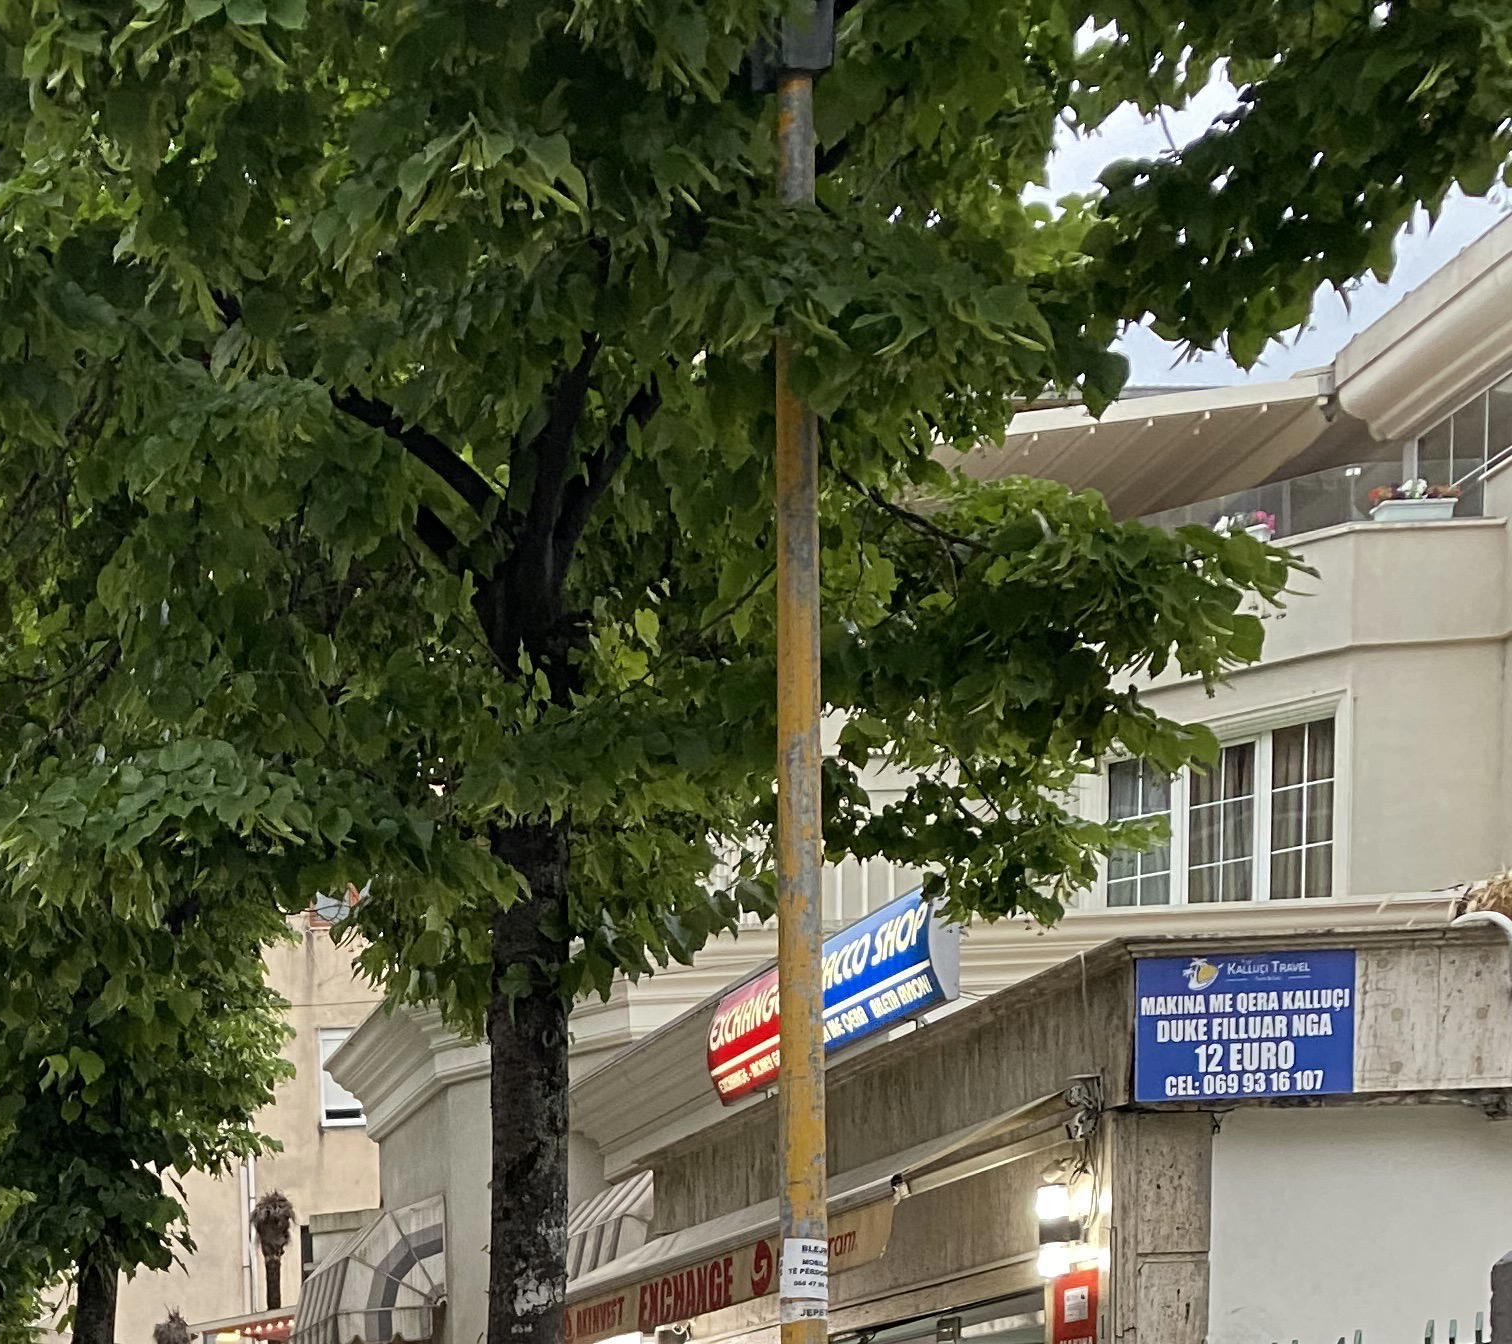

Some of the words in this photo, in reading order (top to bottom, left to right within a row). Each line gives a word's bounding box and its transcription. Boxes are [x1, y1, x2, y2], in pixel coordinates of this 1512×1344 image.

[710, 984, 780, 1051] EXCHANG
[822, 932, 870, 992] ACCO
[872, 902, 929, 965] SHOP
[1271, 960, 1311, 973] TRAVEL
[1141, 995, 1206, 1016] MAKINA
[1209, 993, 1233, 1014] ME
[1237, 991, 1279, 1014] QERA
[1282, 988, 1350, 1012] KALLUÇI
[1156, 1018, 1208, 1042] DUKE
[1212, 1015, 1287, 1040] FILLUAR
[1292, 1013, 1333, 1037] NGA
[1195, 1043, 1223, 1073] 12
[1230, 1040, 1295, 1071] EURO
[1165, 1075, 1200, 1097] CEL:
[1203, 1073, 1239, 1095] 069
[1242, 1072, 1266, 1093] 93
[1270, 1071, 1291, 1091] 16
[1294, 1070, 1324, 1091] 107
[638, 1256, 734, 1328] EXCHANGE
